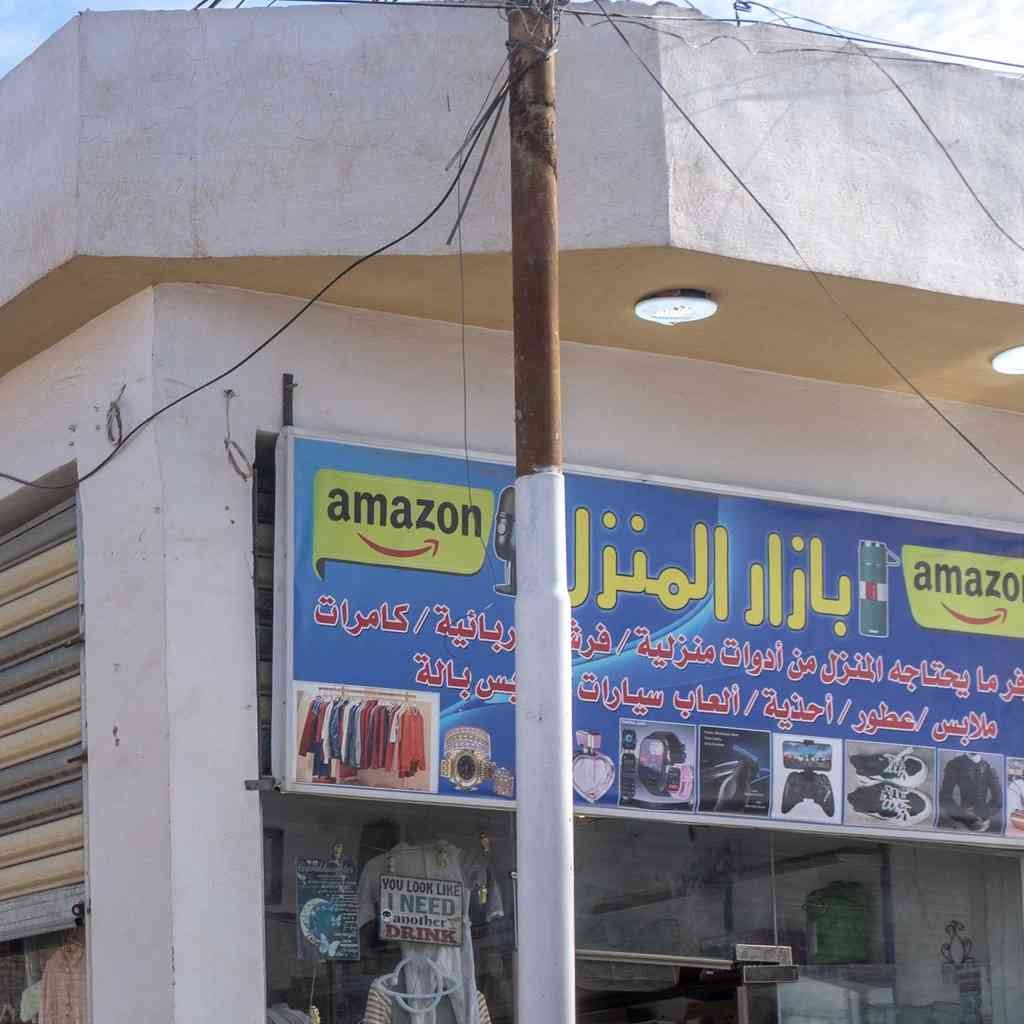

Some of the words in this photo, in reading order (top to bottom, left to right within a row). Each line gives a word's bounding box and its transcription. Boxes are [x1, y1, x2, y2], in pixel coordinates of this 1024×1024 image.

[327, 487, 482, 537] amazon
[567, 505, 729, 622] المنزل
[913, 560, 1024, 602] amazo
[744, 531, 852, 637] بازار
[313, 593, 411, 637] كامرات
[635, 625, 716, 669] منزلية
[720, 638, 784, 677] أدوات
[787, 648, 817, 681] من
[412, 651, 473, 700] بالة
[819, 650, 884, 686] المنزل
[888, 659, 971, 699] يحتاجه
[976, 665, 999, 693] ما
[576, 671, 665, 717] سيارات
[671, 682, 740, 720] ألعاب
[763, 688, 834, 730] أحذية
[931, 710, 998, 746] ملابس
[382, 877, 404, 892] YOU
[406, 880, 434, 895] LOOK
[436, 883, 462, 897] LIKE
[387, 893, 394, 911] I
[399, 895, 456, 916] NEED
[384, 924, 457, 944] DRINK
[391, 914, 448, 928] another
